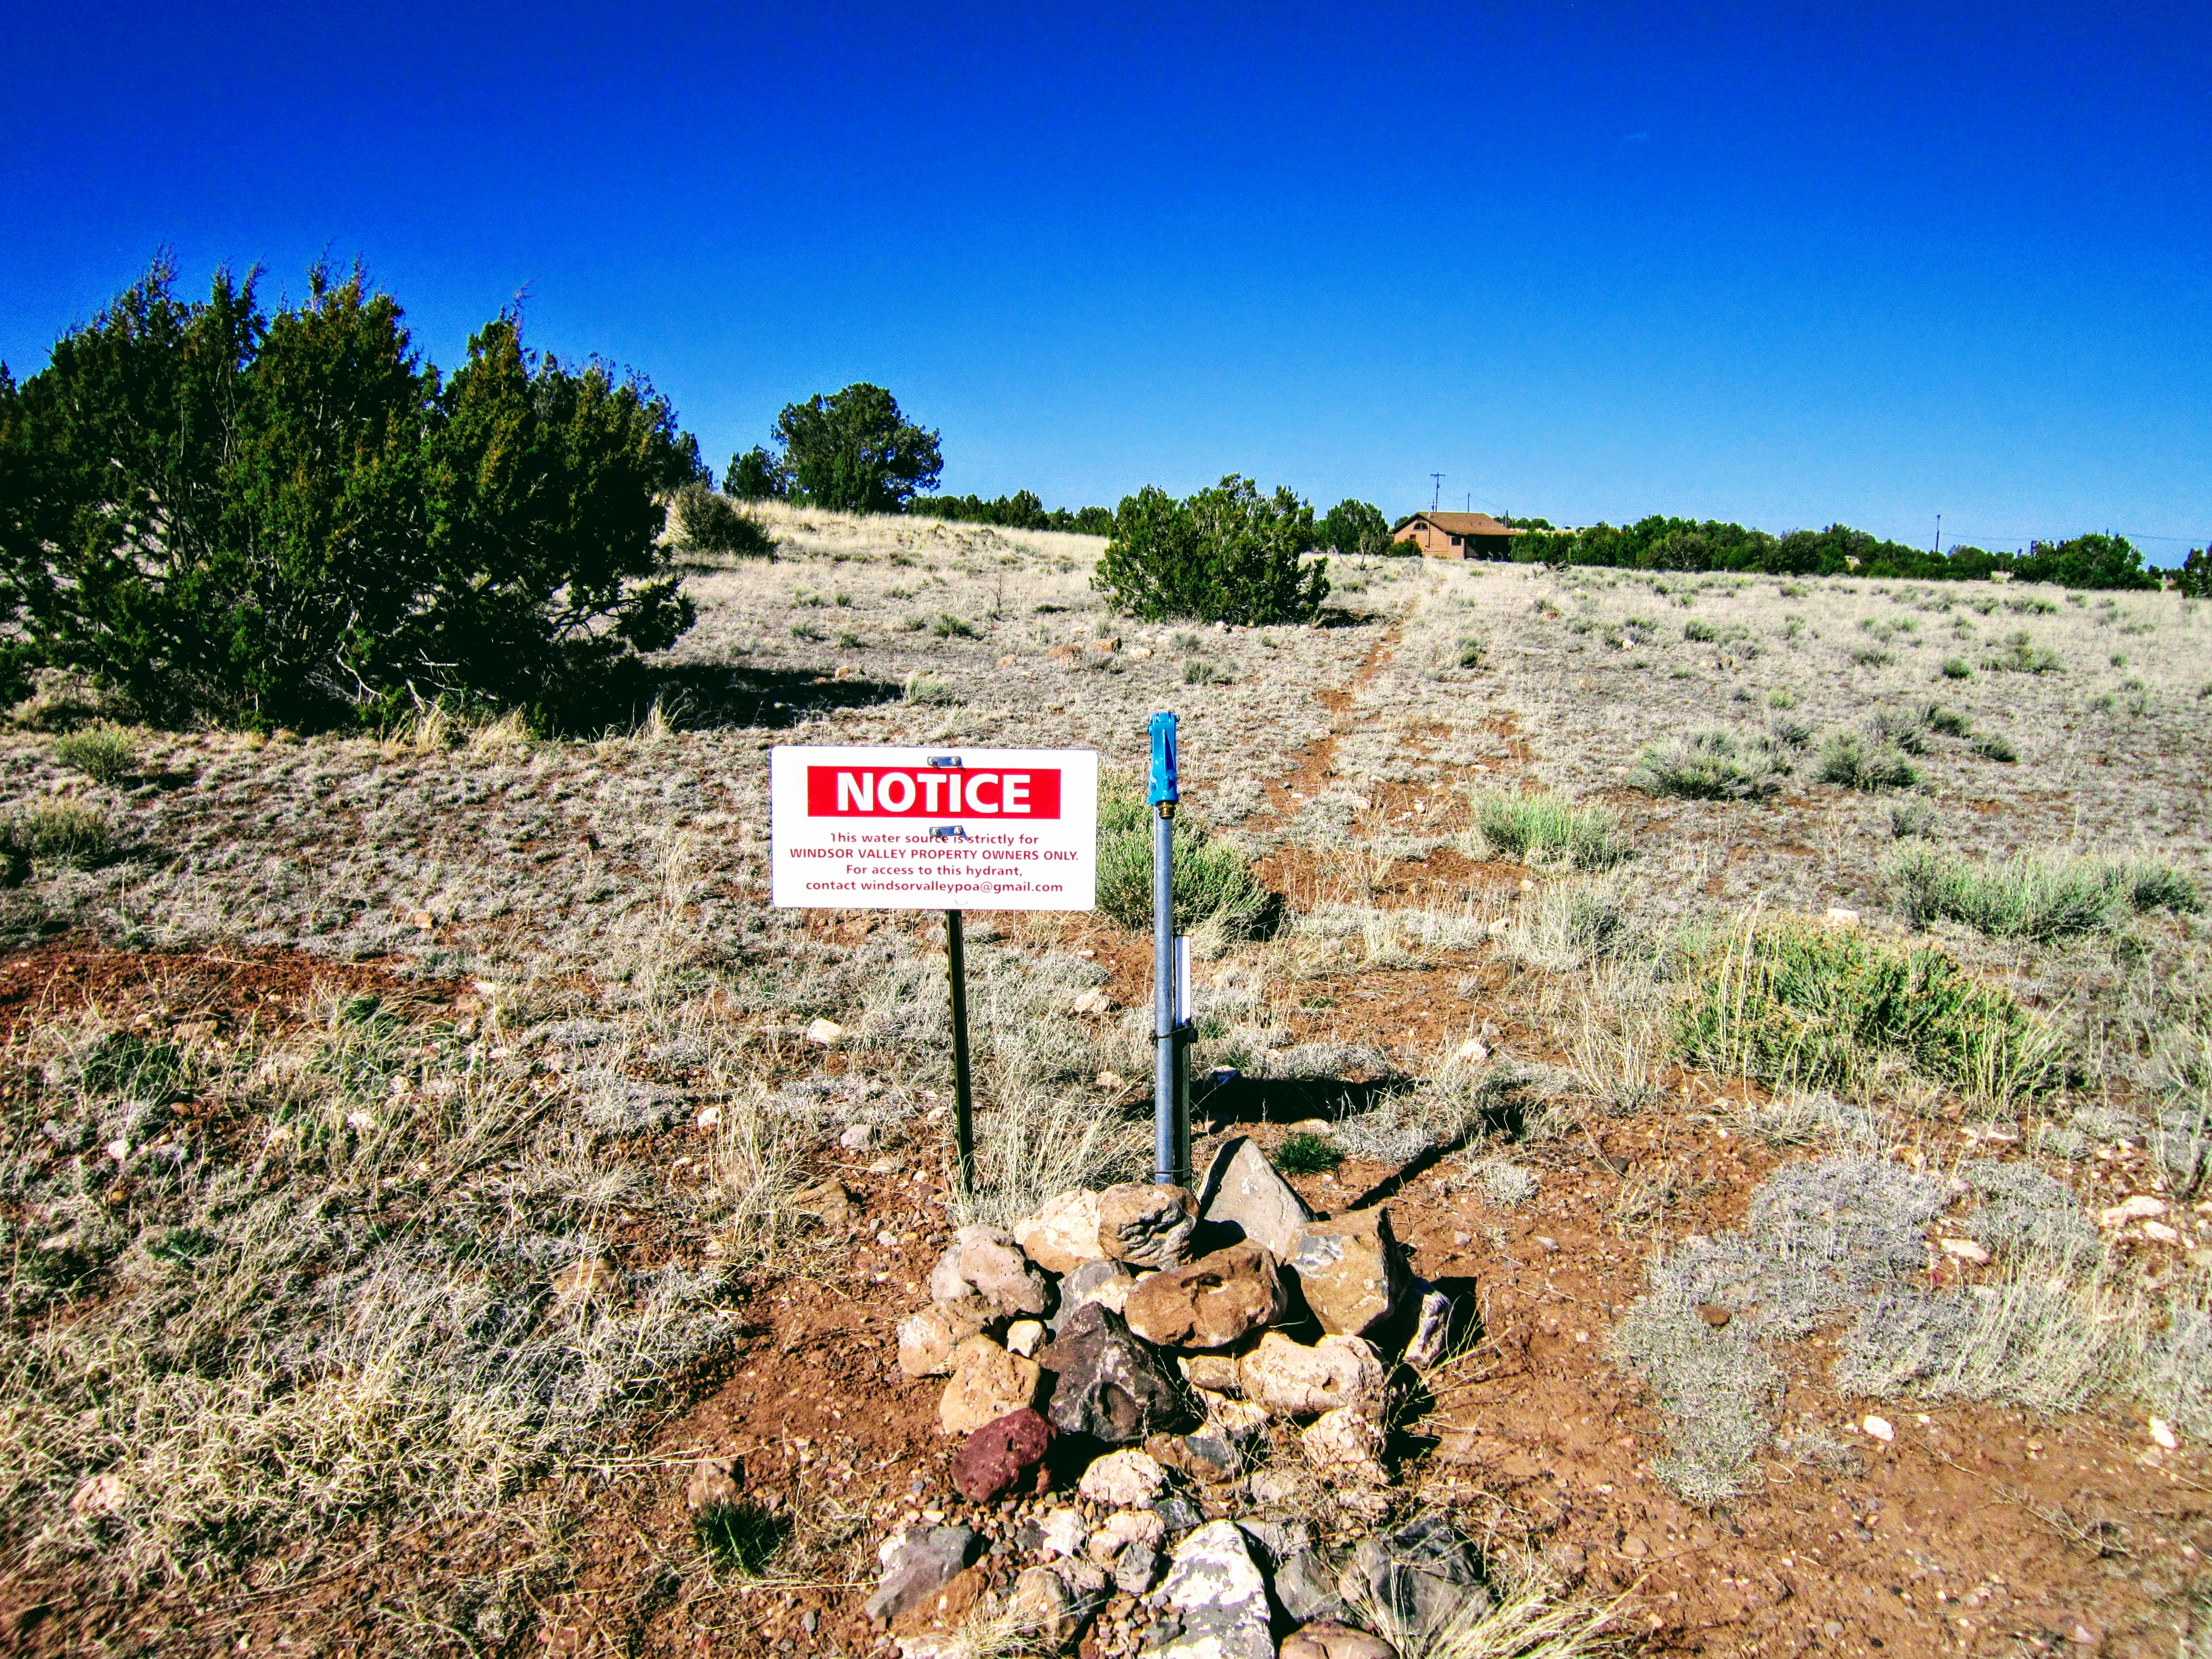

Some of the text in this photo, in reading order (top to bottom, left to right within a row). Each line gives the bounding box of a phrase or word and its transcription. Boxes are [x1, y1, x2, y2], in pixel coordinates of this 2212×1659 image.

[838, 772, 1031, 813] NOTICE
[830, 832, 1039, 847] This water source is strictly for
[790, 848, 1079, 861] WINDSOR VALLEY PROPERTY OWNERS ONLY.
[846, 865, 1022, 878] For access to this hydrant,
[806, 880, 1063, 894] contact windsorvalleypoa@gmail.com
